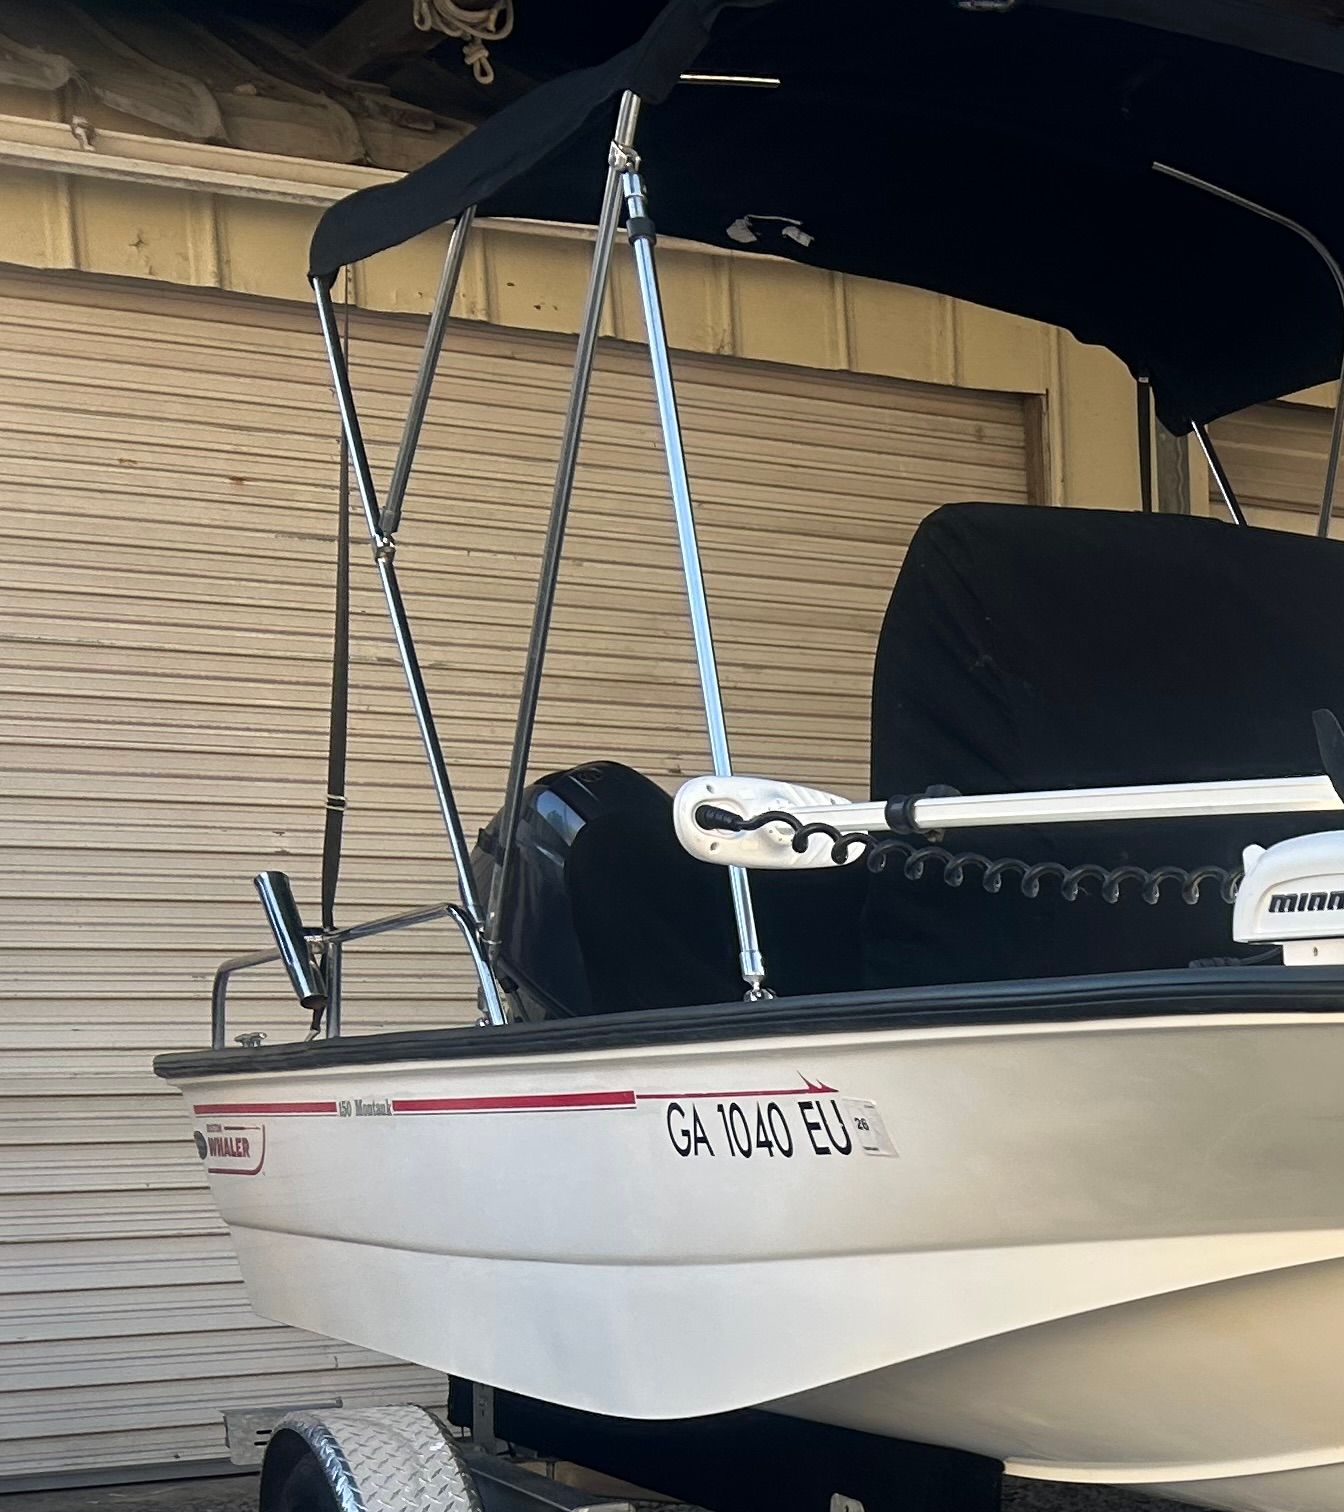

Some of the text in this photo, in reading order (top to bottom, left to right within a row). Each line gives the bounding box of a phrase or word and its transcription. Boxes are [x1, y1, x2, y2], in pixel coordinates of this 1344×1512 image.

[208, 1136, 250, 1158] WHALER
[667, 1099, 852, 1158] GA 1040 EU
